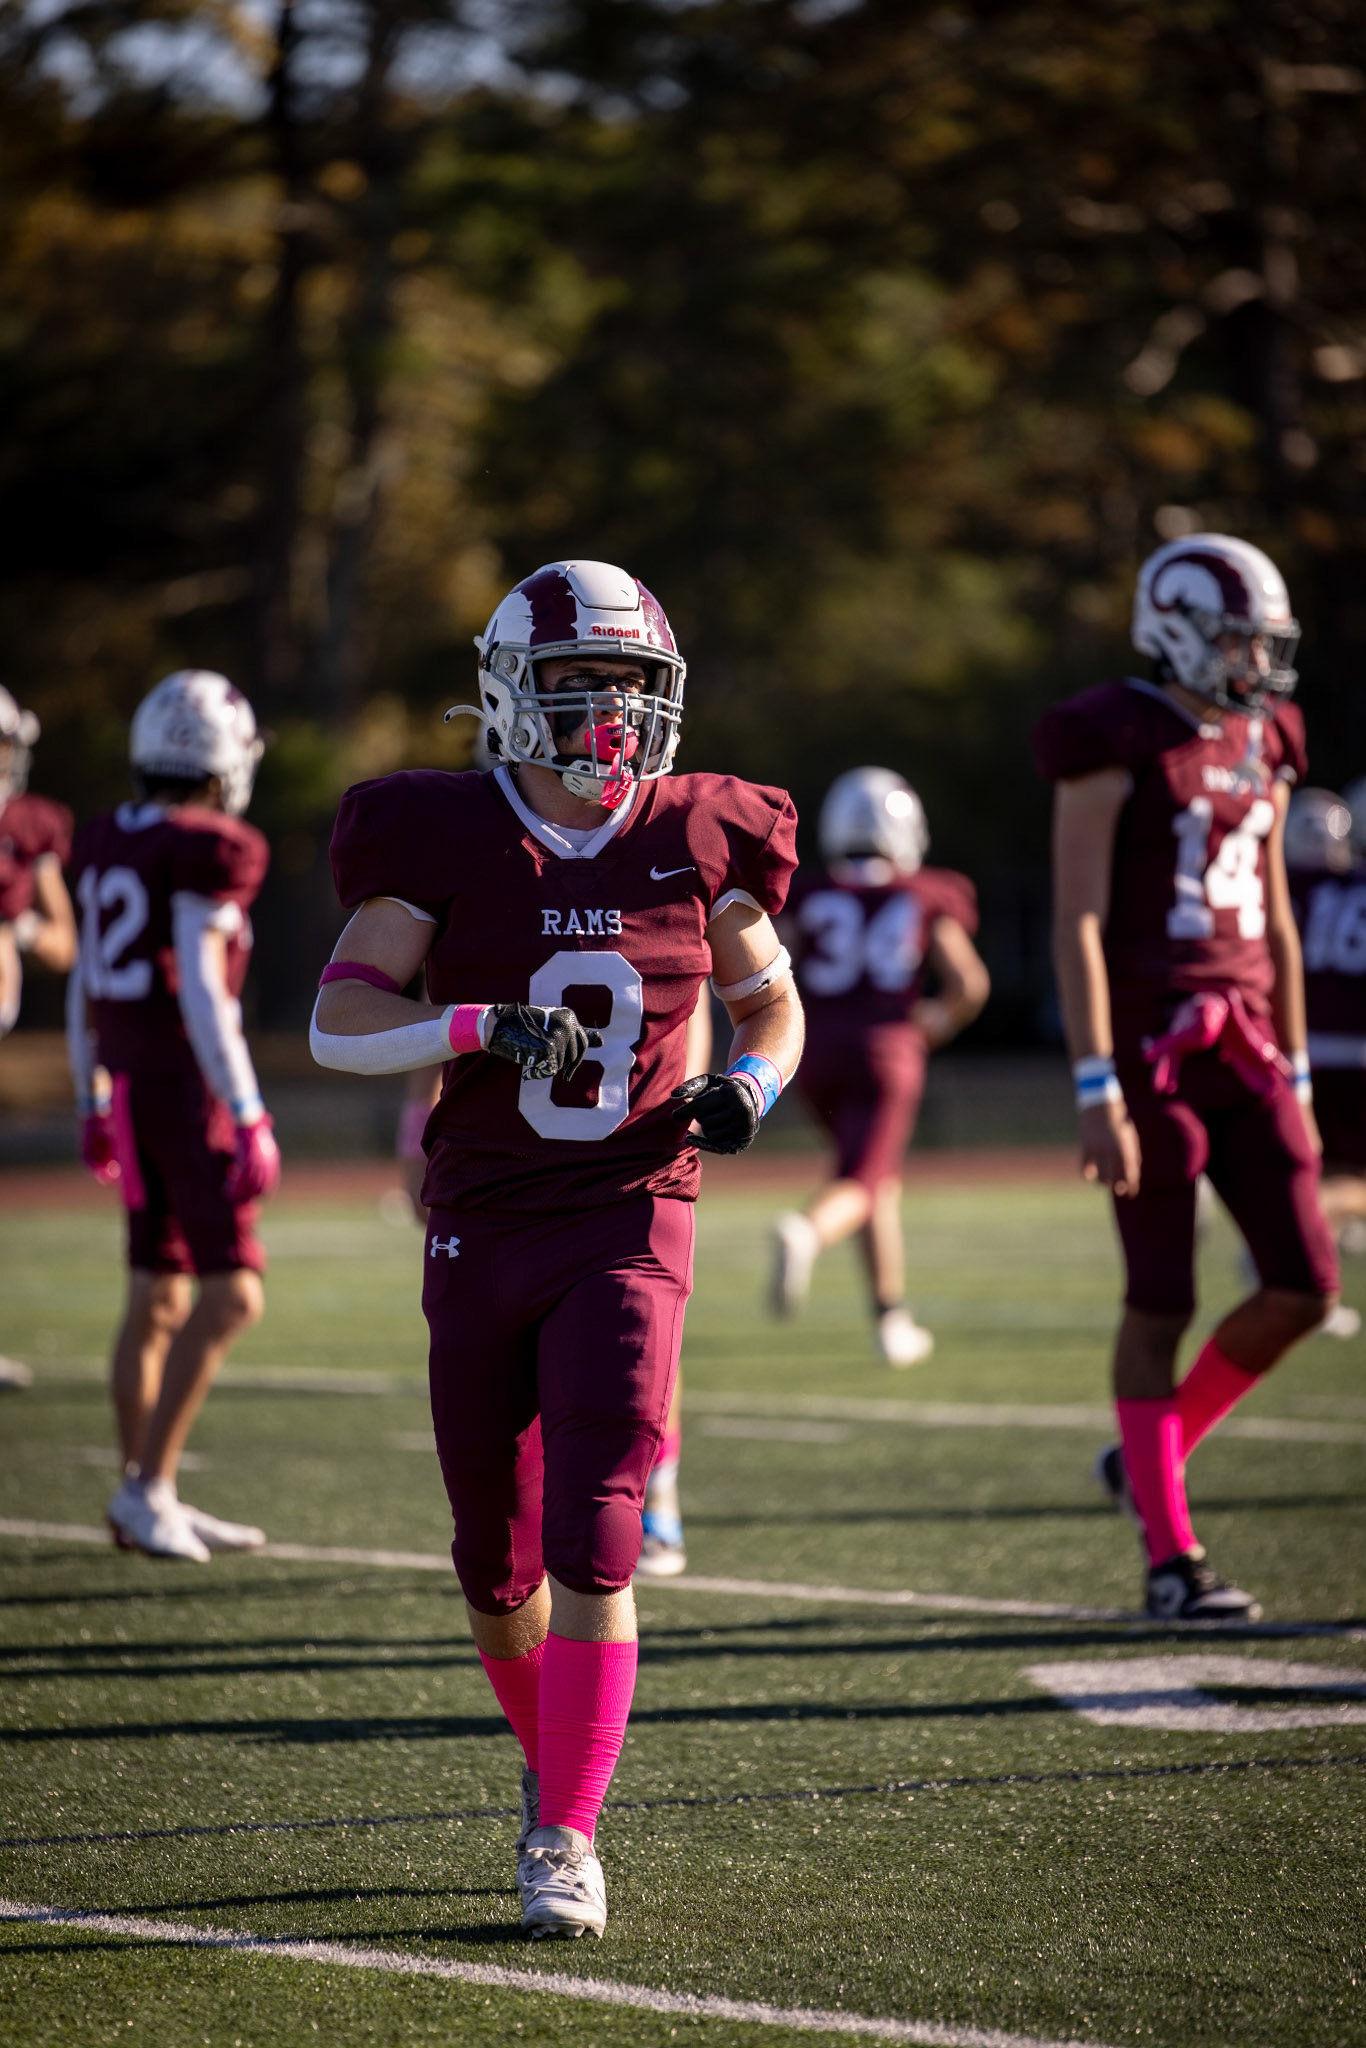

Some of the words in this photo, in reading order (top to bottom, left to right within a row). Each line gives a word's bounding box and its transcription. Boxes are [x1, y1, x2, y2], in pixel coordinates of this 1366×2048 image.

[591, 625, 640, 639] Riddell
[541, 908, 622, 935] RAMS
[1167, 797, 1275, 940] 14
[78, 865, 153, 999] 12
[800, 888, 922, 996] 34
[518, 950, 643, 1140] 8
